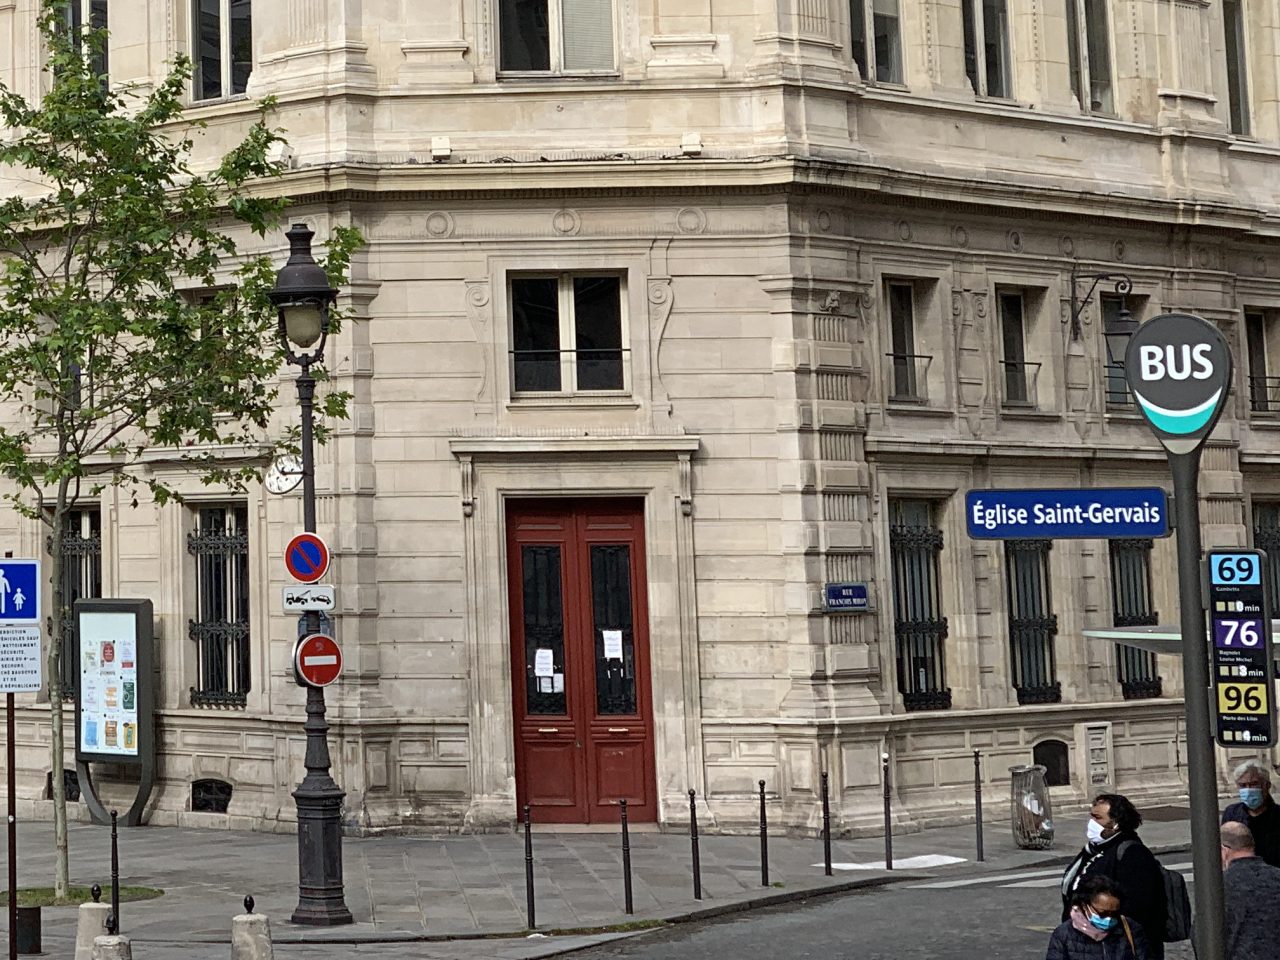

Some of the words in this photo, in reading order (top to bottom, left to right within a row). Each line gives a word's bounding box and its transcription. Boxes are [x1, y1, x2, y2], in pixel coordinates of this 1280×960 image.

[1140, 343, 1214, 381] BUS
[972, 500, 1028, 530] Église
[1033, 502, 1161, 525] Saint-Gervais
[1218, 556, 1254, 582] 69
[1244, 604, 1260, 612] min
[1221, 620, 1259, 647] 76
[1248, 669, 1264, 677] min
[1224, 685, 1261, 711] 96
[1252, 734, 1267, 742] min
